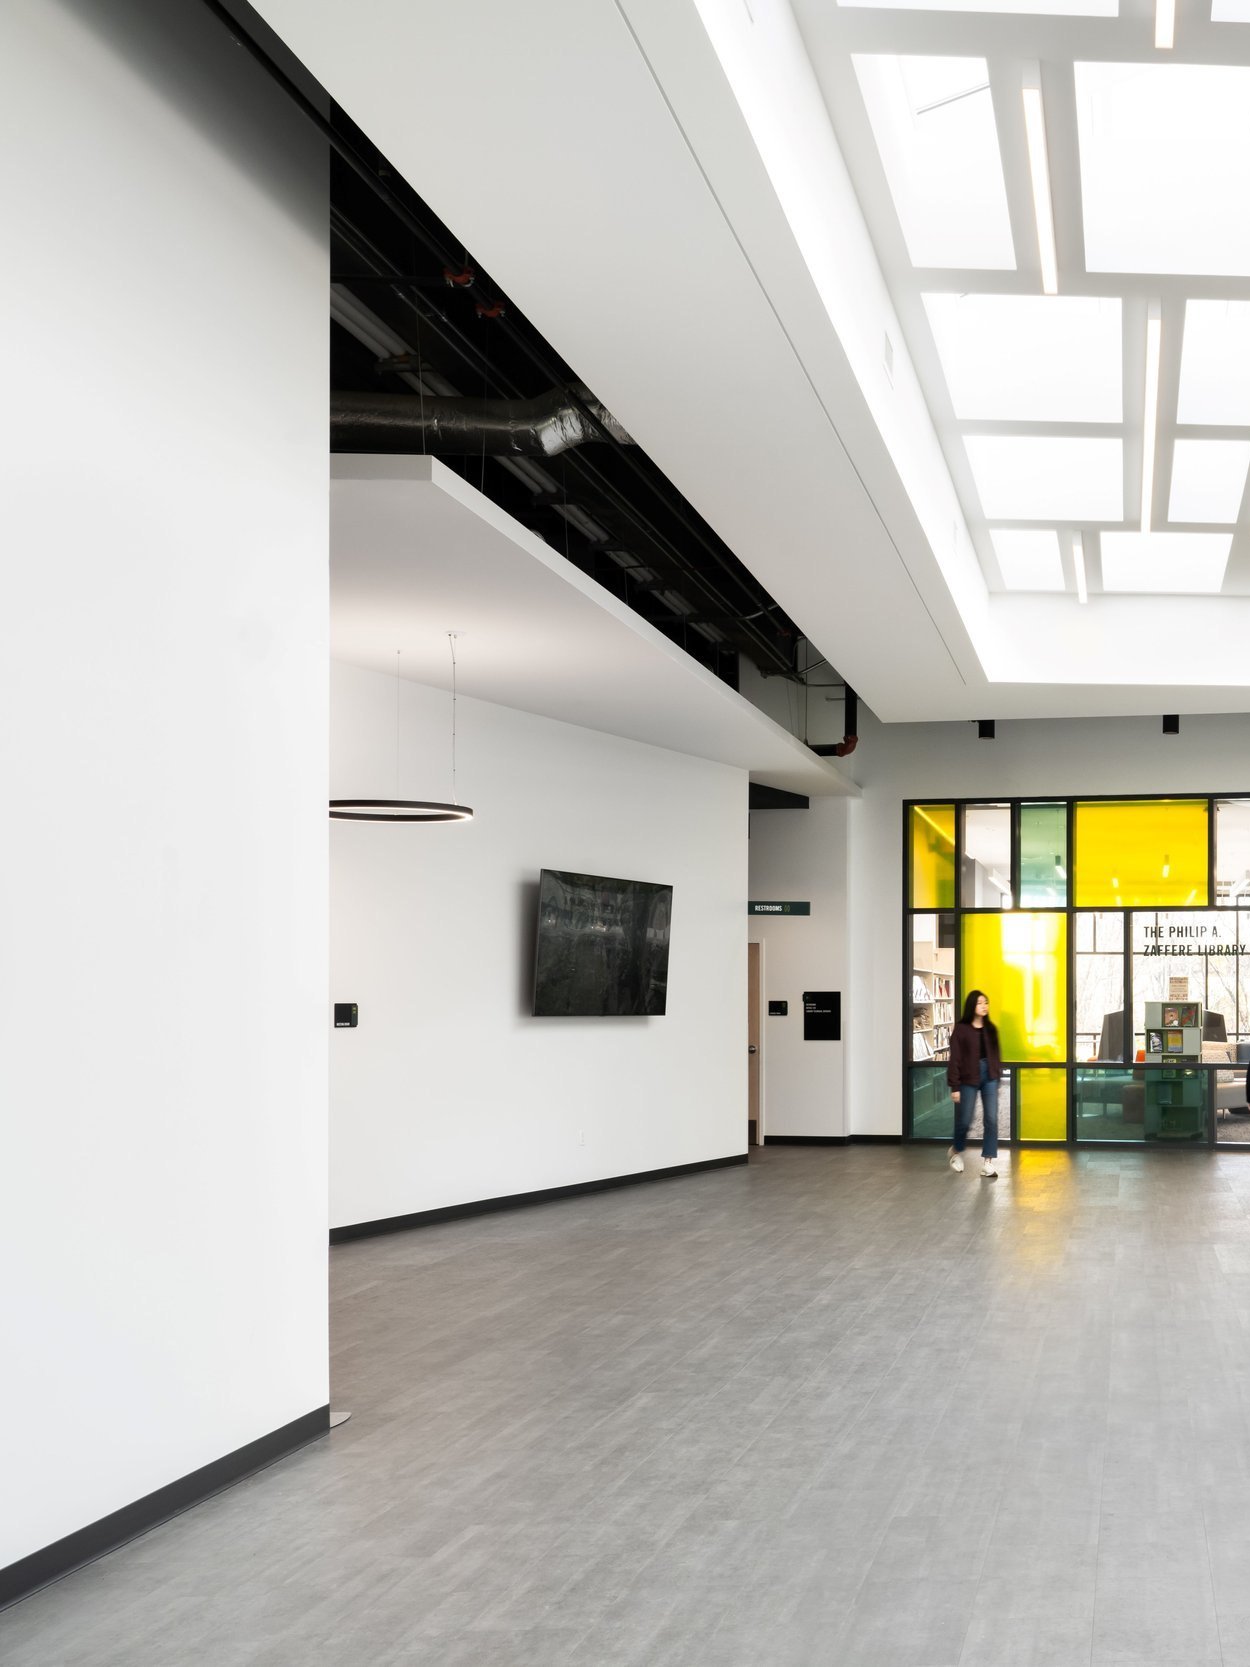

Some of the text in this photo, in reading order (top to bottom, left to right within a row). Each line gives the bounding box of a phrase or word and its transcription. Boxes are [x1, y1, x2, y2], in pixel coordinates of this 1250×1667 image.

[1144, 926, 1222, 938] THE PHILIP A.
[1143, 944, 1246, 956] ZAFFERE LIBRARY
